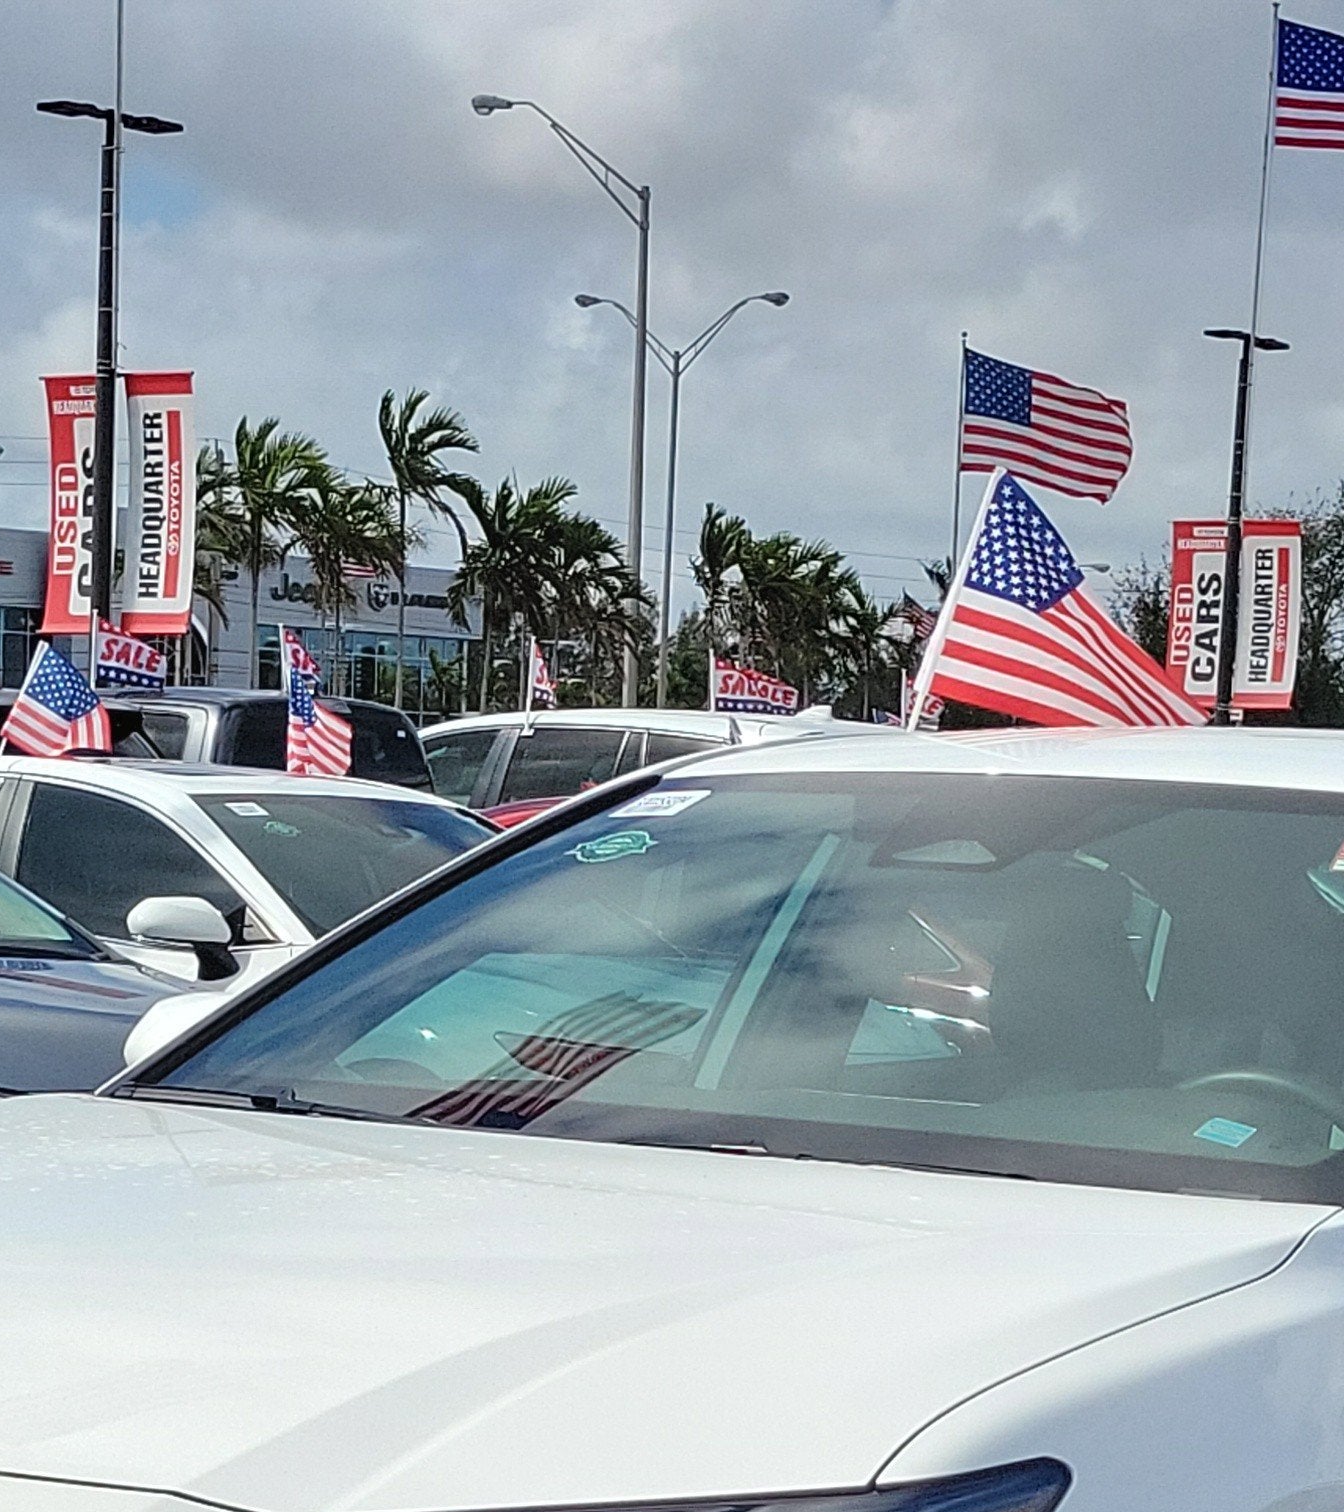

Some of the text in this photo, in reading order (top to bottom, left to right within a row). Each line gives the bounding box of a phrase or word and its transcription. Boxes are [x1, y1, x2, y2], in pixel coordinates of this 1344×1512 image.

[53, 463, 79, 575] USED
[138, 411, 166, 599] HEADQUARTER
[168, 461, 181, 535] TOYOTA
[100, 637, 161, 674] SALE
[1170, 584, 1194, 666] USED
[1191, 572, 1223, 682] CARS
[1248, 548, 1274, 682] HEADQUARTER
[1276, 583, 1290, 639] TOYOTA
